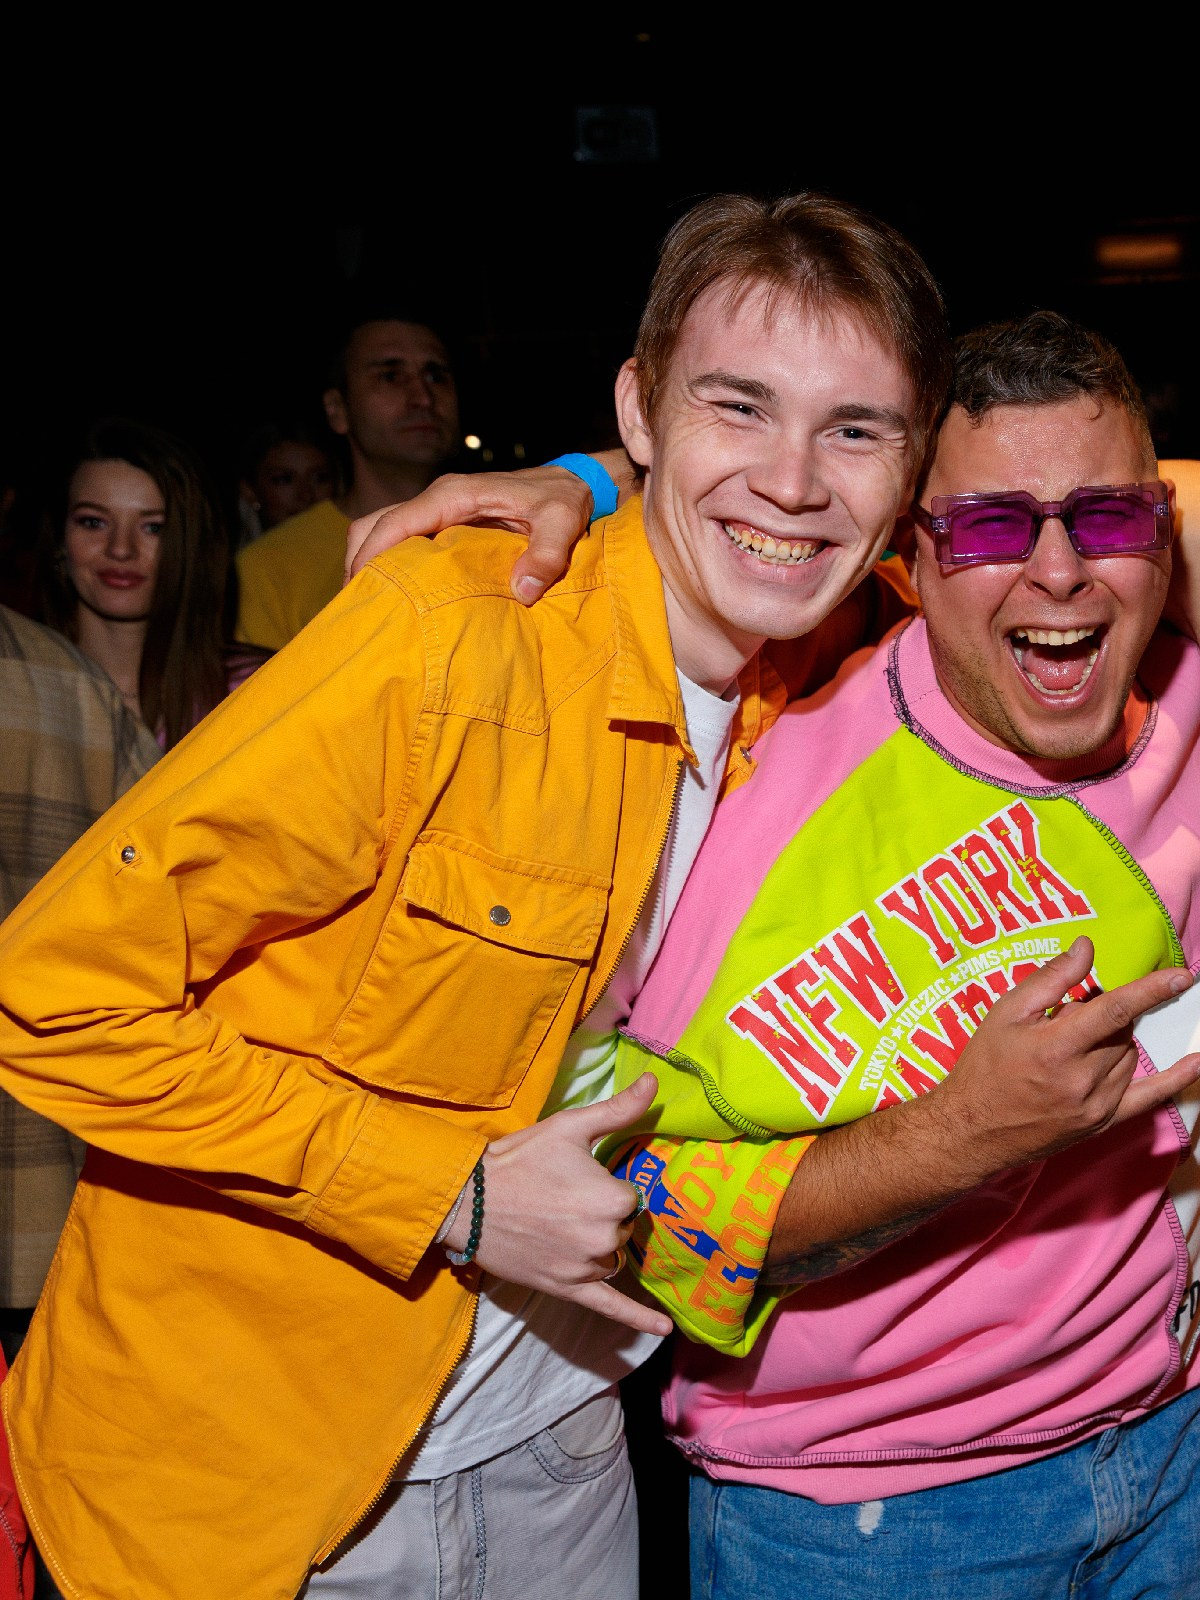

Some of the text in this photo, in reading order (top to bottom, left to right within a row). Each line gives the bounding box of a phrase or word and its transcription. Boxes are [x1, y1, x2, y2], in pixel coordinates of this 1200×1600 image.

[874, 798, 1098, 970] YORK
[859, 1035, 898, 1091] TOKYO
[955, 949, 1002, 977] PIMS
[1012, 938, 1062, 957] ROME
